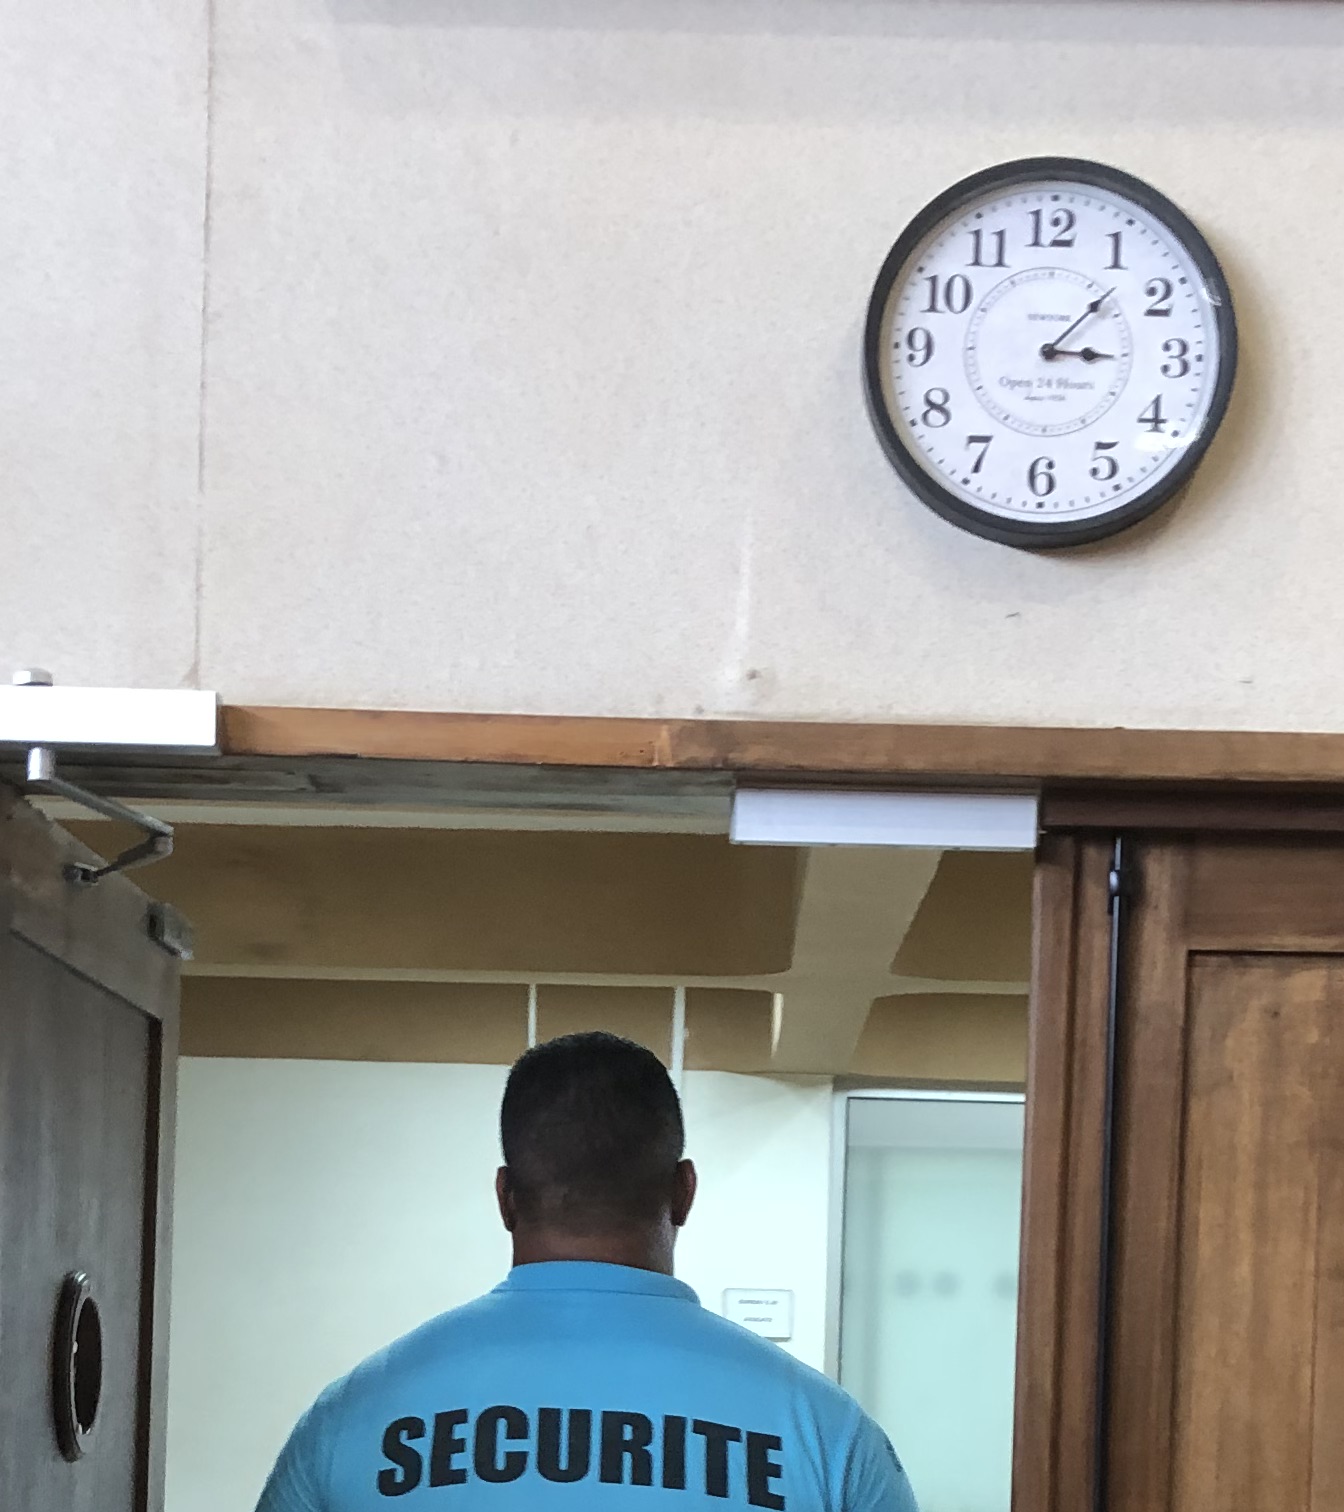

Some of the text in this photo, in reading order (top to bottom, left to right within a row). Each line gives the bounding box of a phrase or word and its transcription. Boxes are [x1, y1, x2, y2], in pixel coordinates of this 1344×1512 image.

[965, 227, 1011, 268] 11
[1025, 207, 1077, 248] 12
[1103, 230, 1128, 270] 1
[919, 273, 974, 315] 10
[1143, 276, 1175, 318] 2
[904, 326, 935, 368] 9
[1160, 337, 1191, 379] 3
[999, 376, 1032, 390] Open
[1037, 377, 1053, 388] 24
[920, 386, 952, 428] 8
[1136, 393, 1168, 434] 4
[965, 434, 994, 475] 7
[1089, 440, 1120, 482] 5
[1026, 455, 1056, 497] 6
[376, 1404, 786, 1512] SECURITE
